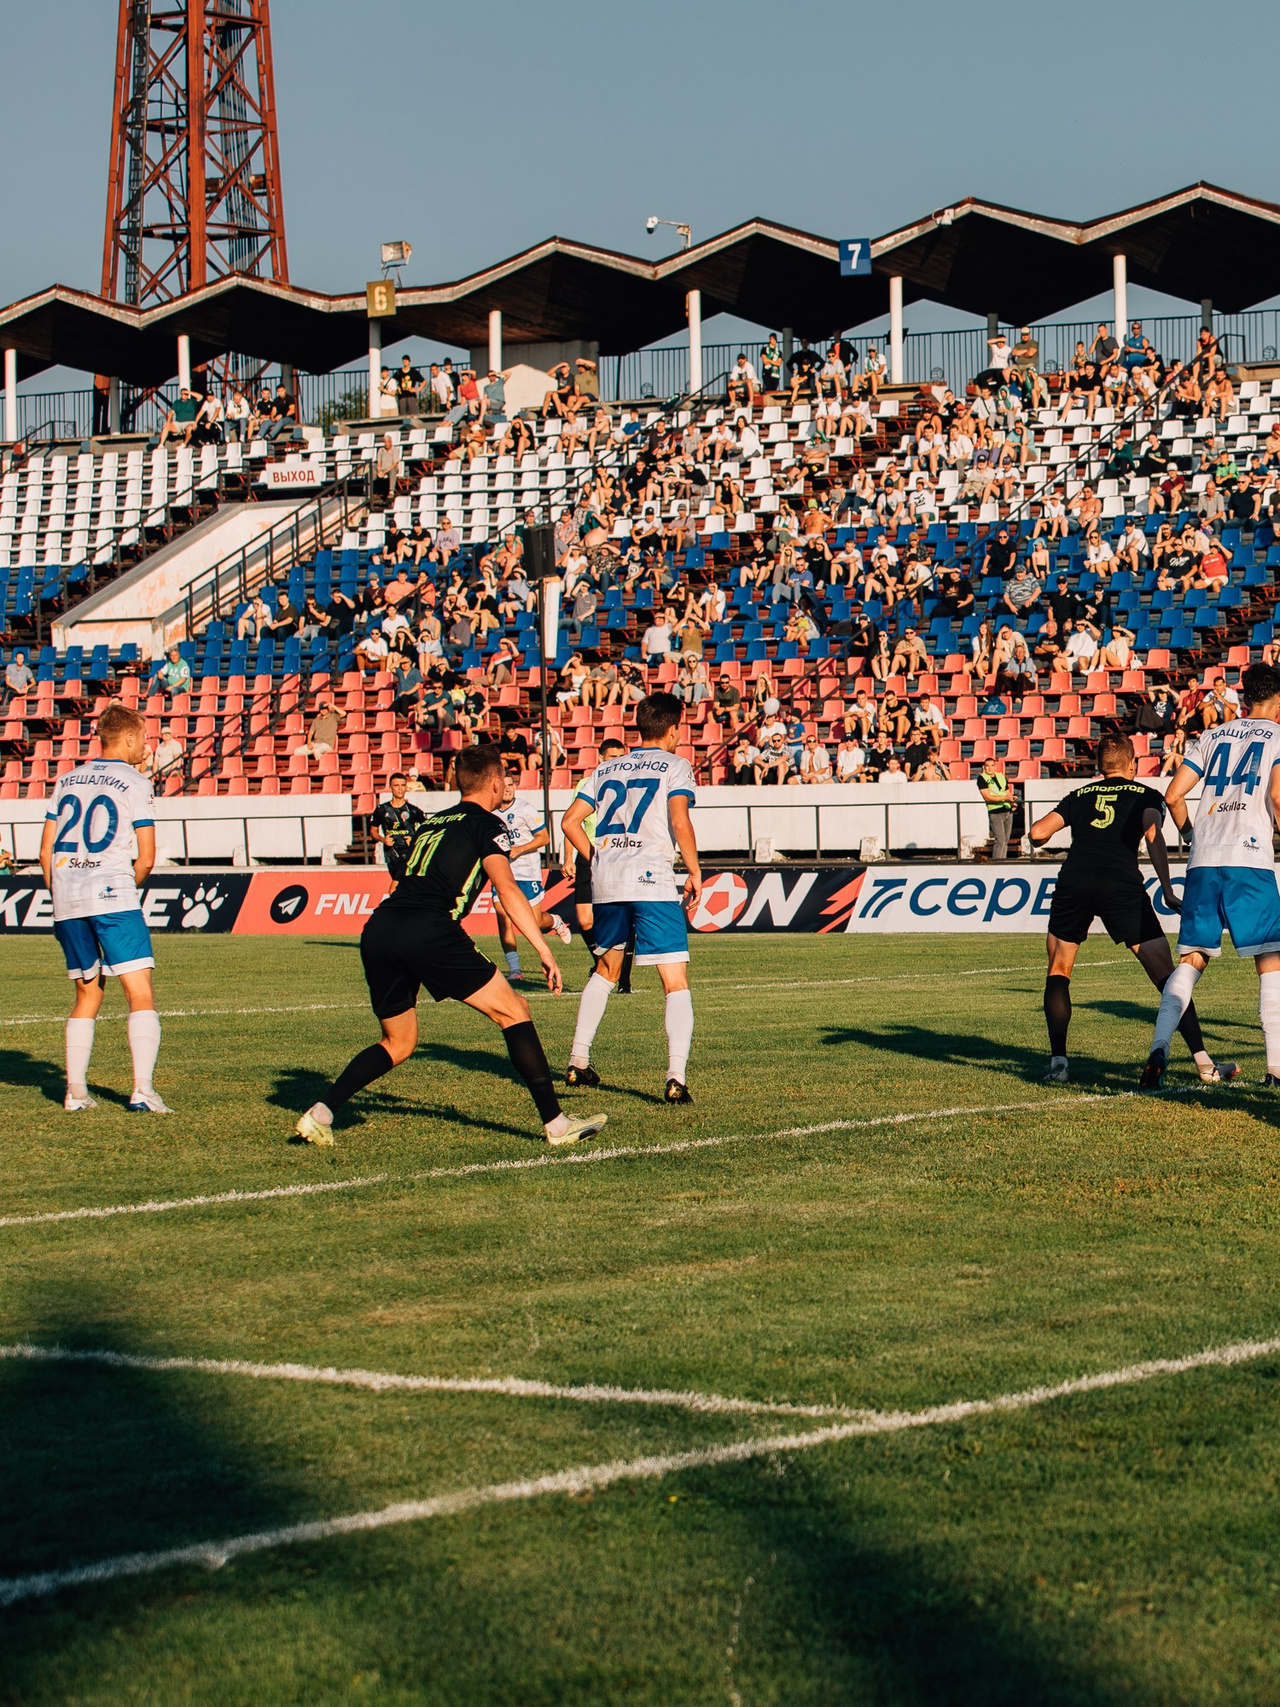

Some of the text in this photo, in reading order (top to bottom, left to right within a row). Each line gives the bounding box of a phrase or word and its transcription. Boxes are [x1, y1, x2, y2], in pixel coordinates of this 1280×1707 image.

[848, 243, 861, 269] 7
[374, 286, 387, 311] 6
[272, 470, 316, 484] ВЫХОД
[597, 761, 669, 778] БЕТЮЖНОВ
[1204, 741, 1266, 797] 44
[60, 774, 130, 793] МЕШАЛКИН
[595, 778, 661, 838] 27
[1090, 794, 1118, 829] 5
[1217, 801, 1247, 813] Skillaz
[53, 793, 120, 854] 20
[405, 828, 448, 877] 11
[611, 837, 643, 849] Skillaz
[531, 881, 540, 894] 8
